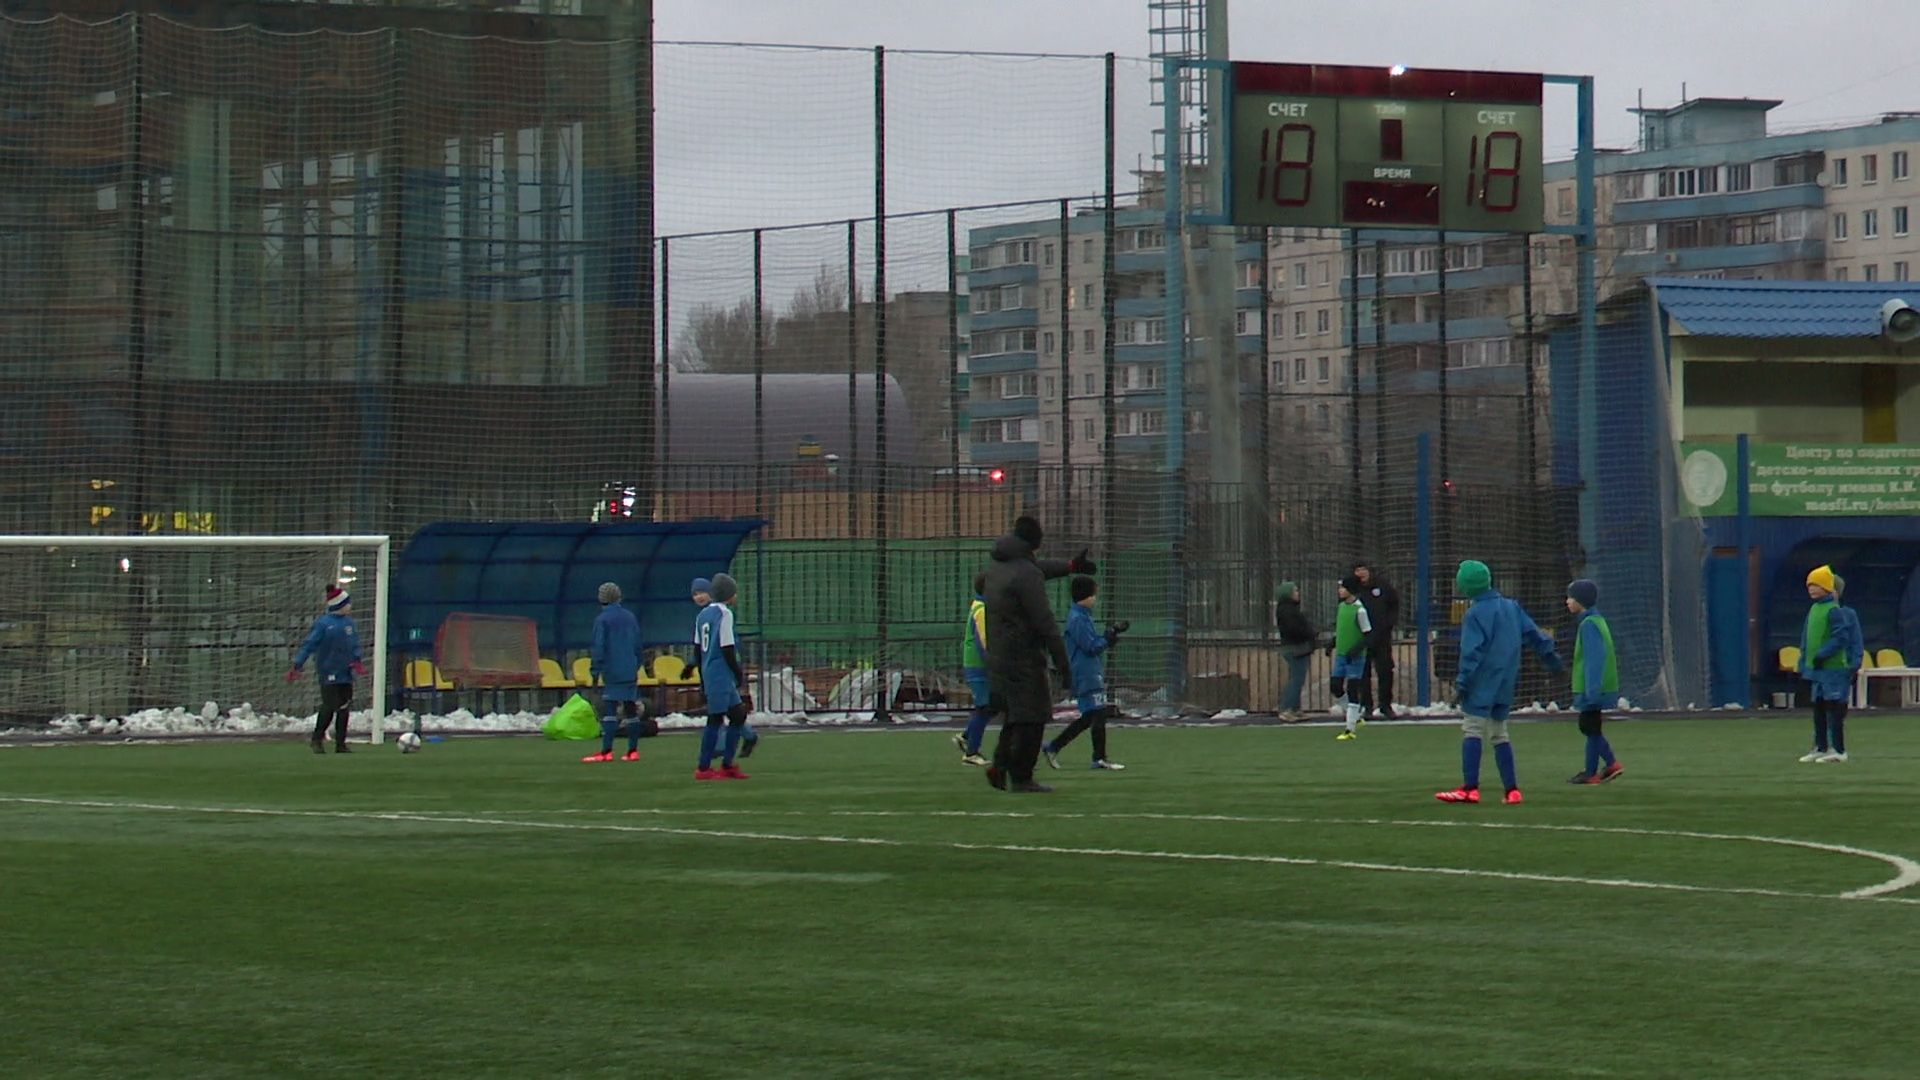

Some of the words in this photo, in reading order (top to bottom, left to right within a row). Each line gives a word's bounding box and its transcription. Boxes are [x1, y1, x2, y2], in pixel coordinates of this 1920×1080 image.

[1268, 102, 1309, 117] СЧЕТ
[1477, 110, 1516, 125] СЧЕТ
[1373, 167, 1412, 180] ВРЕМЯ
[1786, 446, 1831, 459] Центр
[1836, 449, 1854, 458] по
[1771, 480, 1834, 496] футболу
[701, 622, 710, 653] 6
